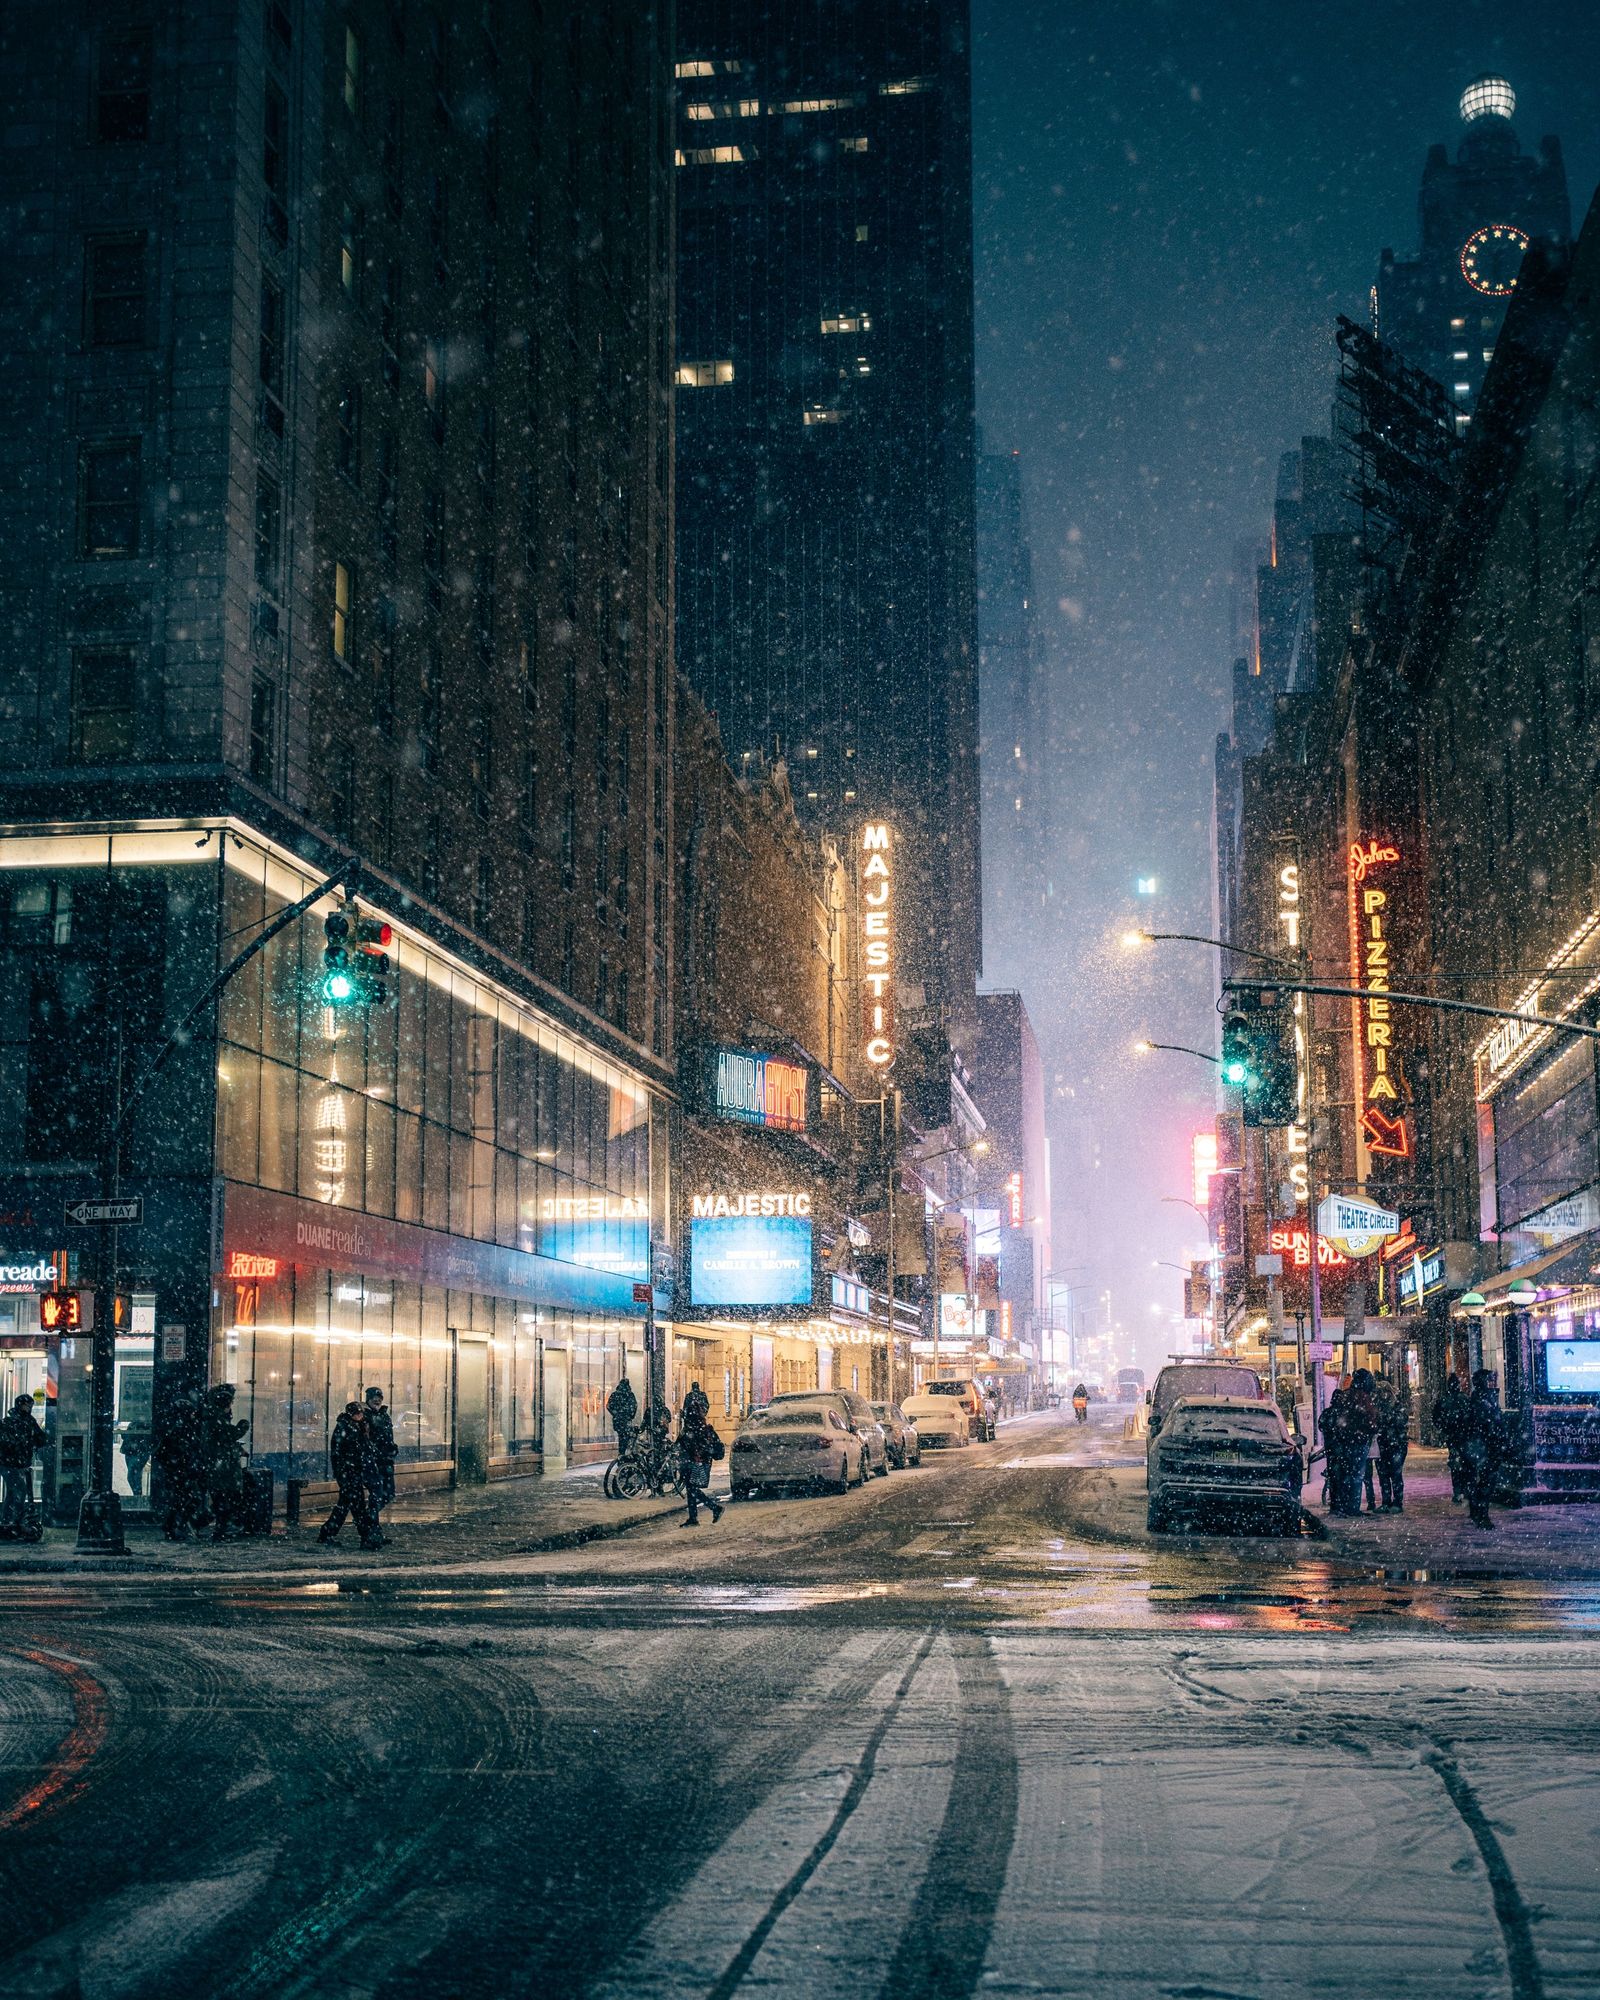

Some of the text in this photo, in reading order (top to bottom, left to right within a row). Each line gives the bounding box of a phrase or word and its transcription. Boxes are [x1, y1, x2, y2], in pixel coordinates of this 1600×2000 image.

[863, 825, 891, 1064] MAJESTIC
[1363, 889, 1398, 1099] PIZZERIA
[716, 1052, 808, 1121] AUDRA GYPSY
[76, 1206, 132, 1219] ONE WAY
[693, 1193, 812, 1217] MAJESTIC
[1337, 1205, 1394, 1230] THEATRE CIRCLE
[1271, 1232, 1328, 1249] SUN
[0, 1259, 58, 1281] reade
[1557, 1435, 1600, 1445] Terminal
